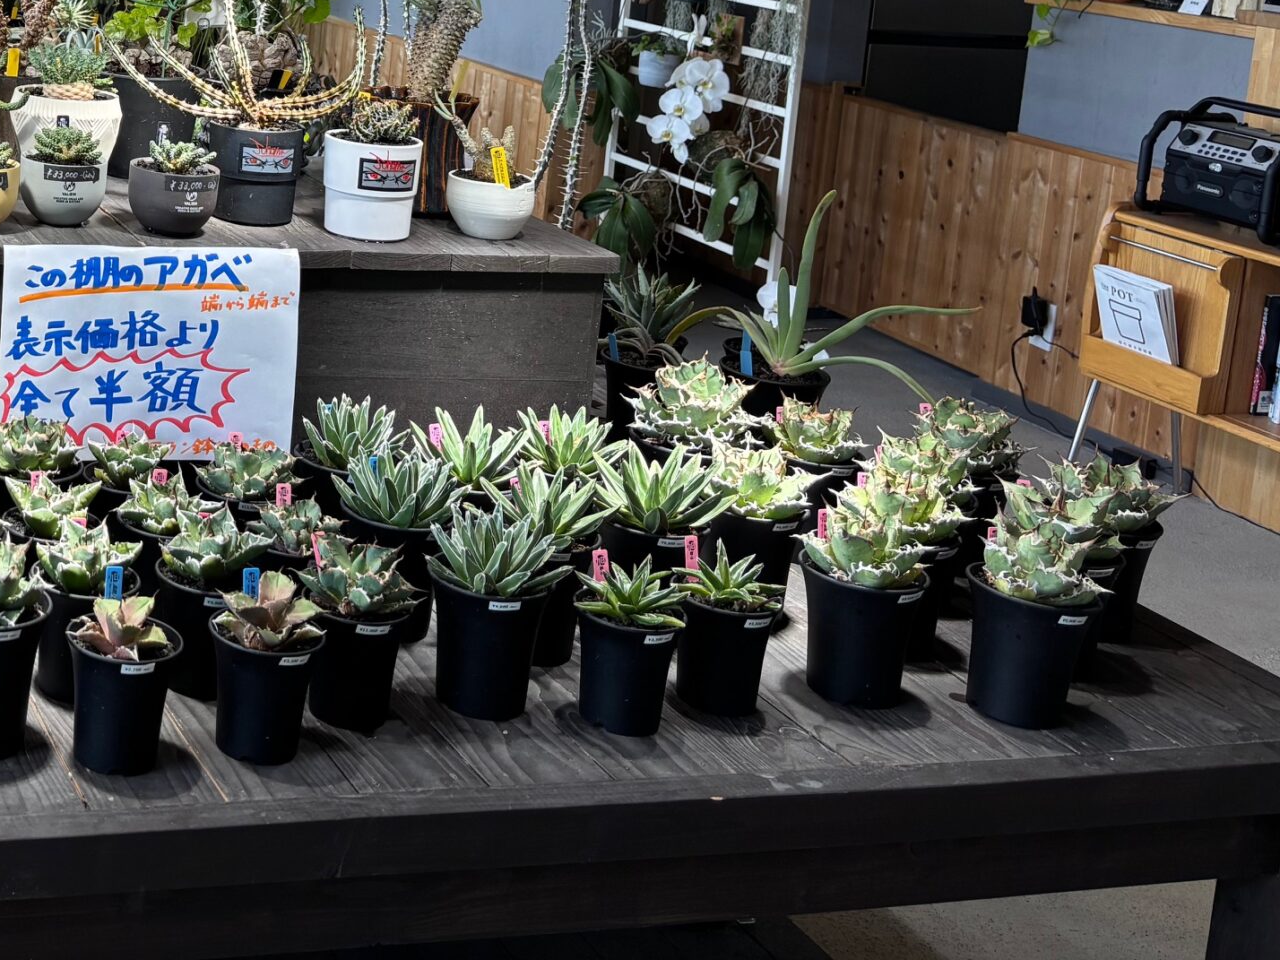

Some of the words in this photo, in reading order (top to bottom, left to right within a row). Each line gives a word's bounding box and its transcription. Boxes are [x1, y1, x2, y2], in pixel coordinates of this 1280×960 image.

[24, 253, 253, 292] この棚のアガベ
[200, 291, 296, 312] 端から端まで
[1111, 285, 1133, 302] POT
[4, 309, 220, 361] 表示価格より
[9, 361, 208, 423] 全て半額
